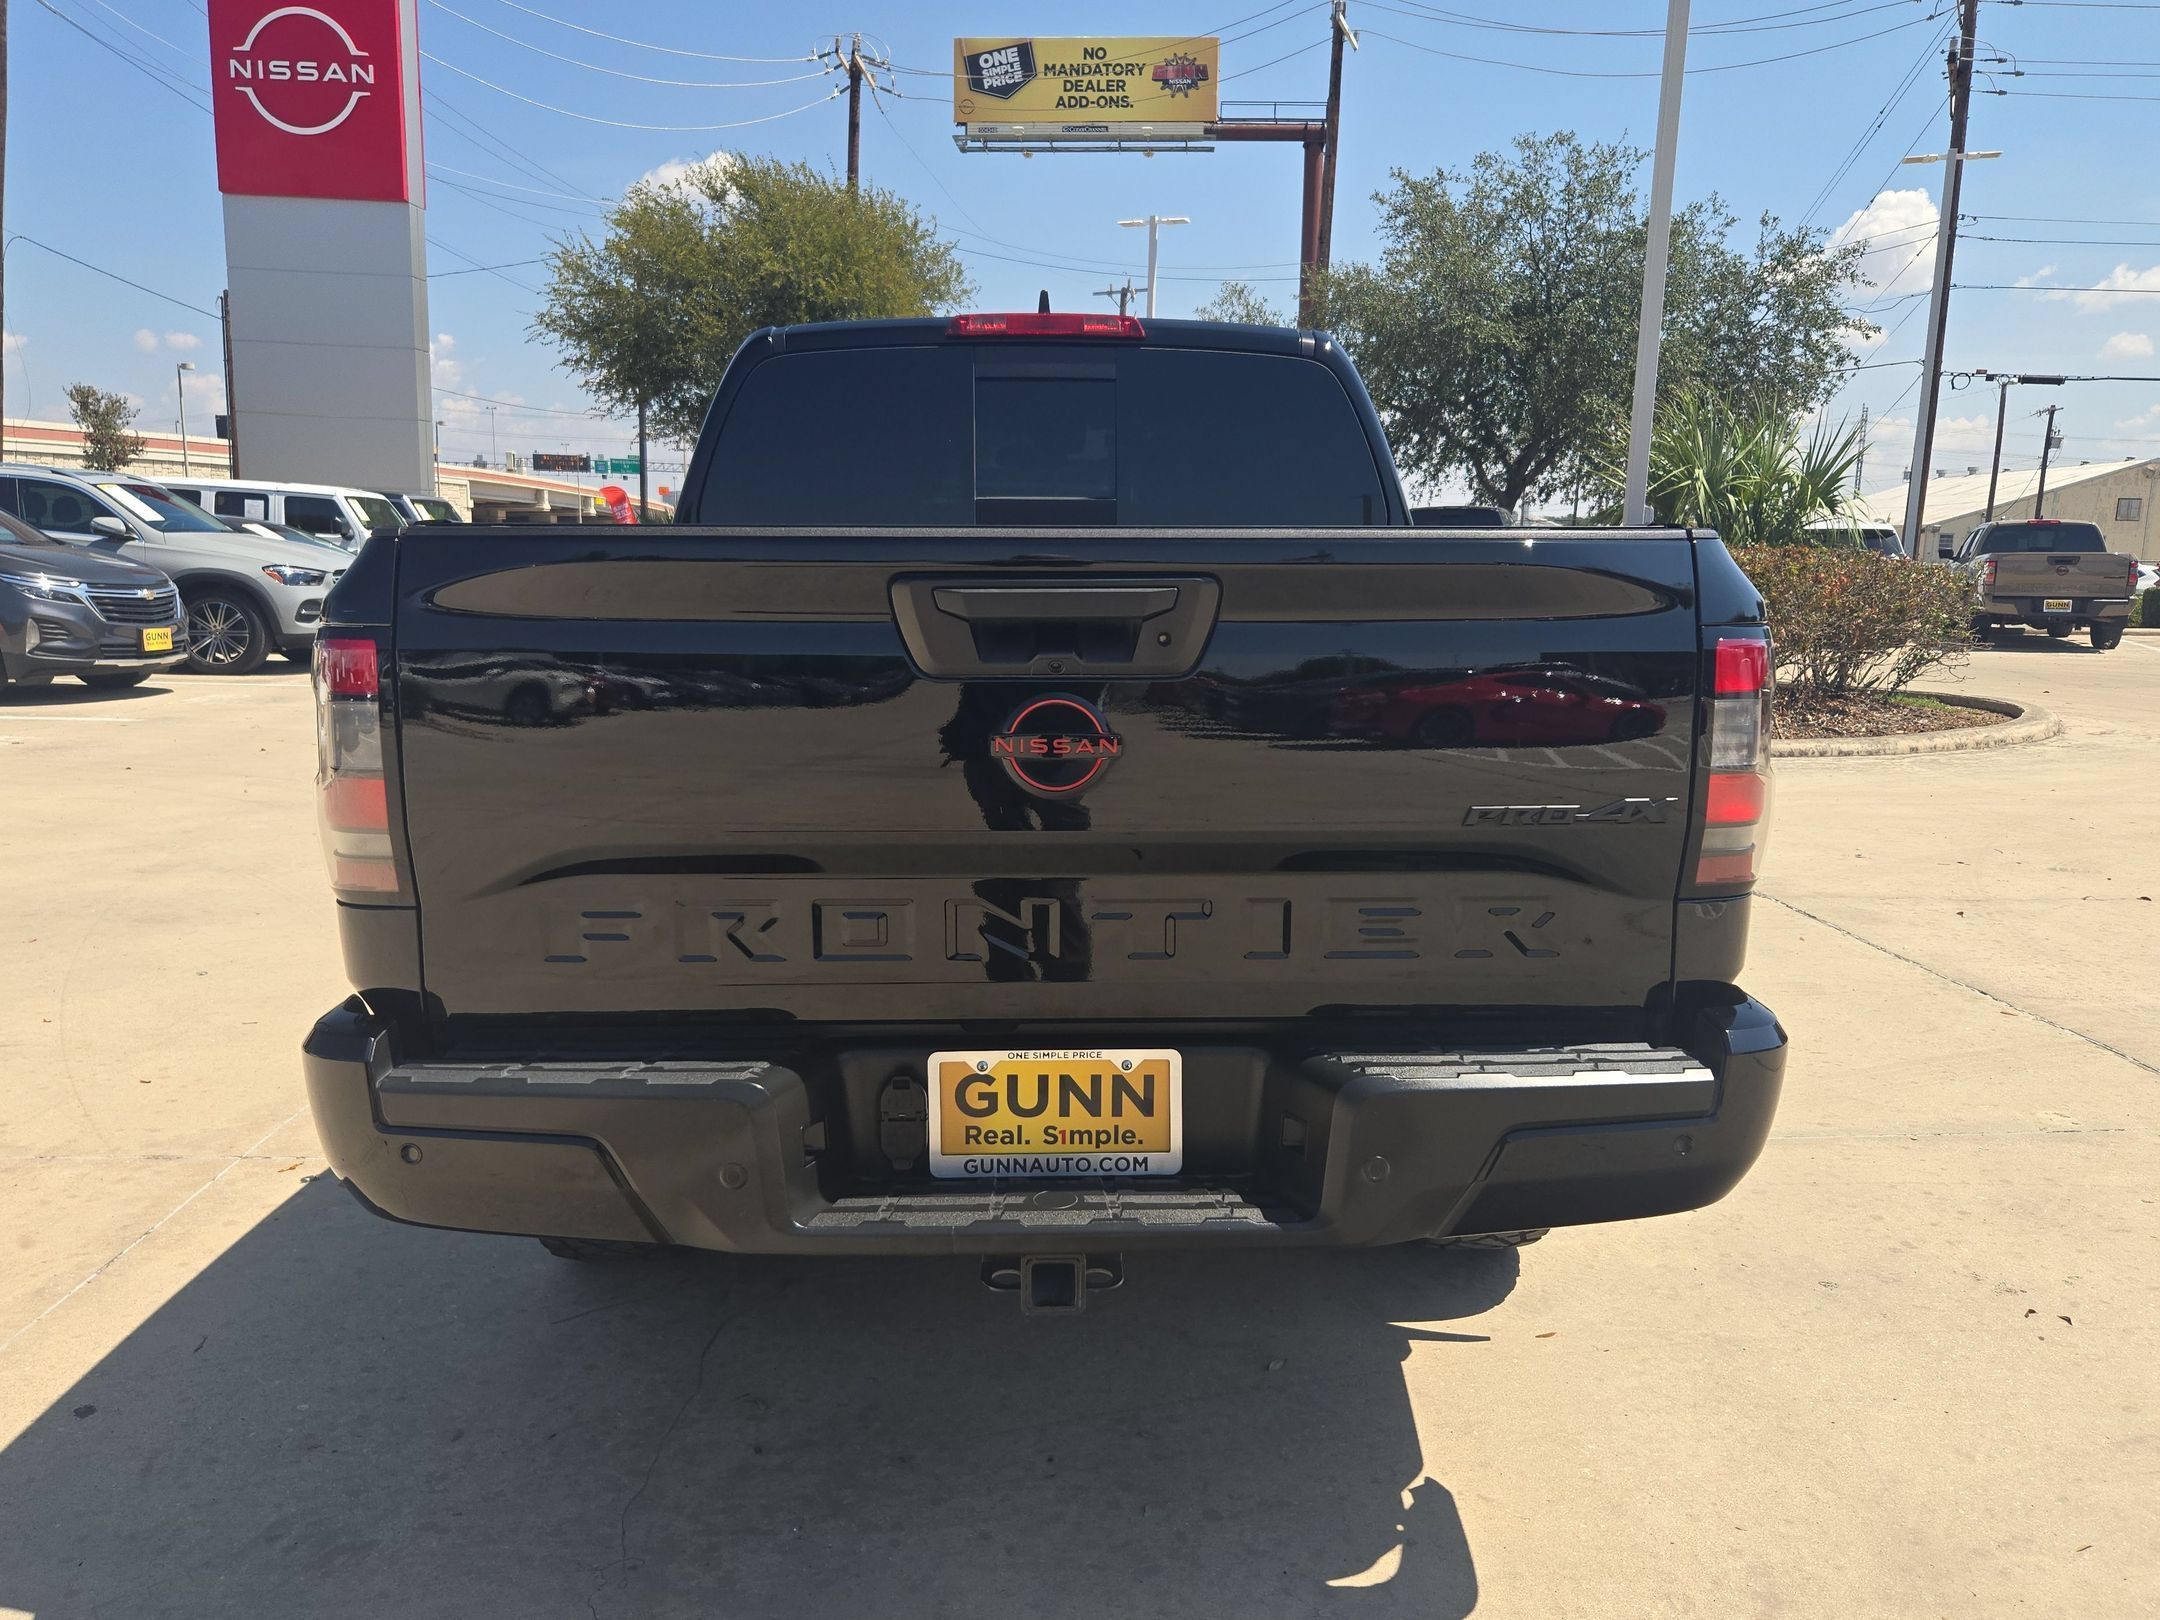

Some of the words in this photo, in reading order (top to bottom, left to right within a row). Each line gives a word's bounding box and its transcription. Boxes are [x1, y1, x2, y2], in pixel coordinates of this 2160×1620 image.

[979, 47, 1020, 68] ONE
[1083, 47, 1107, 61] NO
[230, 59, 375, 84] NISSAN
[982, 61, 1022, 77] SIMPLE
[1043, 63, 1147, 76] MANDATORY
[983, 70, 1024, 90] PRICE
[1063, 79, 1126, 93] DEALER
[1055, 95, 1134, 109] ADD-ONS.
[145, 632, 169, 641] GUNN
[994, 737, 1118, 754] NISSAN
[1462, 797, 1678, 826] PRO-4X
[543, 898, 1561, 962] FRONTIER
[1007, 1051, 1031, 1060] ONE
[1033, 1051, 1069, 1060] SIMPLE
[1072, 1051, 1103, 1059] PRICE
[955, 1073, 1154, 1118] GUNN
[965, 1125, 1031, 1145] Real.
[1042, 1125, 1144, 1149] S1mple.
[964, 1156, 1149, 1175] GUNNAUTO.COM
